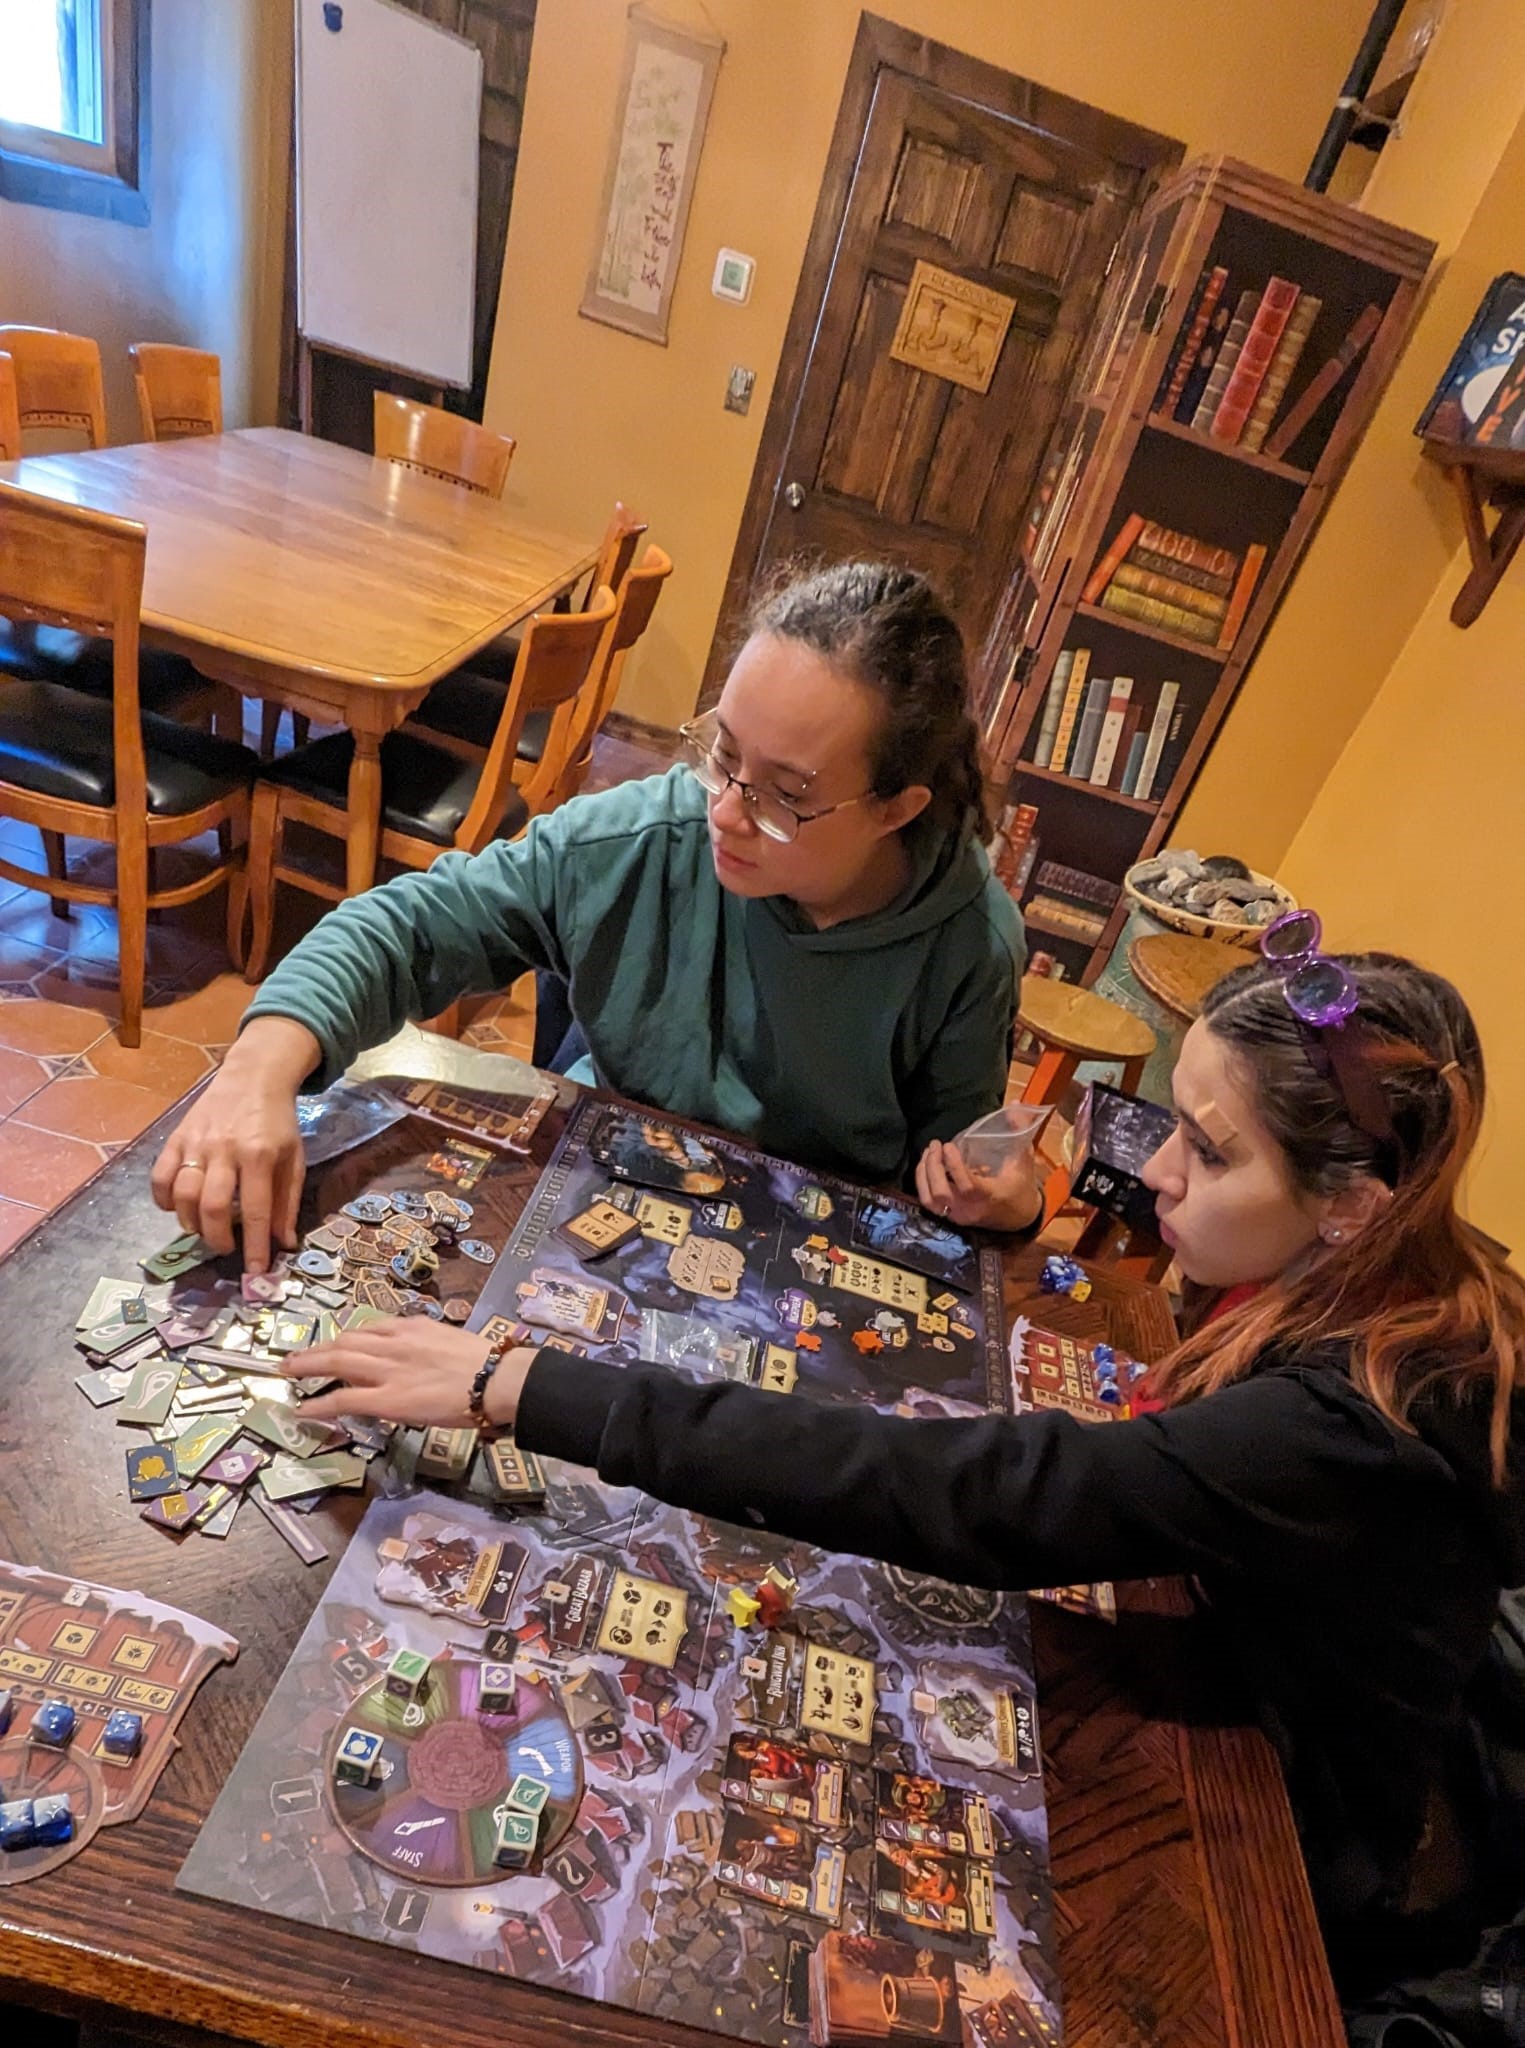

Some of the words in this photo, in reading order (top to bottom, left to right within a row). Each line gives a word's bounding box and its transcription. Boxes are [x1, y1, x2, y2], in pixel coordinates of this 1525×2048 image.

[572, 1568, 593, 1599] BAZAAR
[565, 1598, 585, 1622] GREAT
[492, 1635, 508, 1659] 4
[771, 1644, 787, 1661] INN
[342, 1657, 368, 1681] 5
[766, 1660, 784, 1698] RINGWAY
[588, 1731, 617, 1746] 3
[278, 1789, 313, 1804] 1
[392, 1845, 423, 1868] STAFF
[556, 1856, 585, 1885] 2
[398, 1894, 416, 1926] 1
